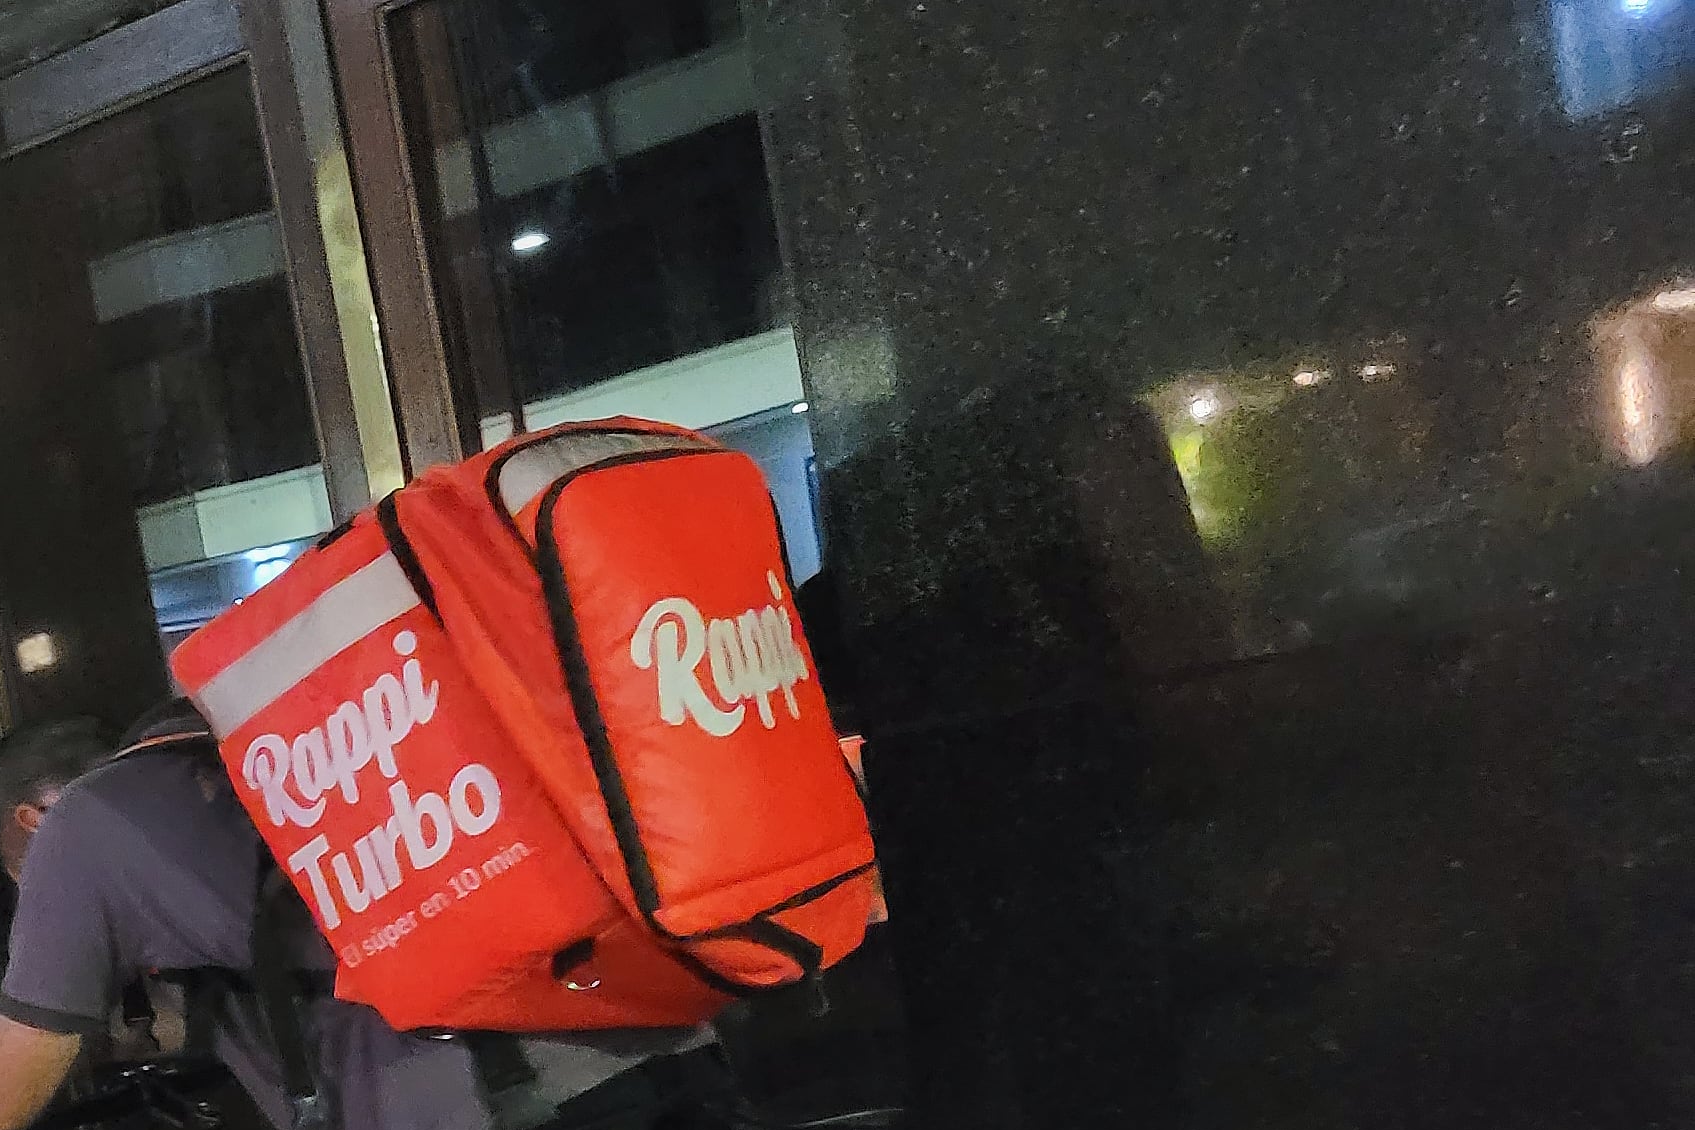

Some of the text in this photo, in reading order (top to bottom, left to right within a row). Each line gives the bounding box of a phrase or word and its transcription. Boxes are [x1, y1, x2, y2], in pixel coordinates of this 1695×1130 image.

[242, 630, 440, 828] Rappi
[631, 569, 809, 737] Rappi
[288, 763, 502, 930] Turbo
[447, 868, 481, 900] 10
